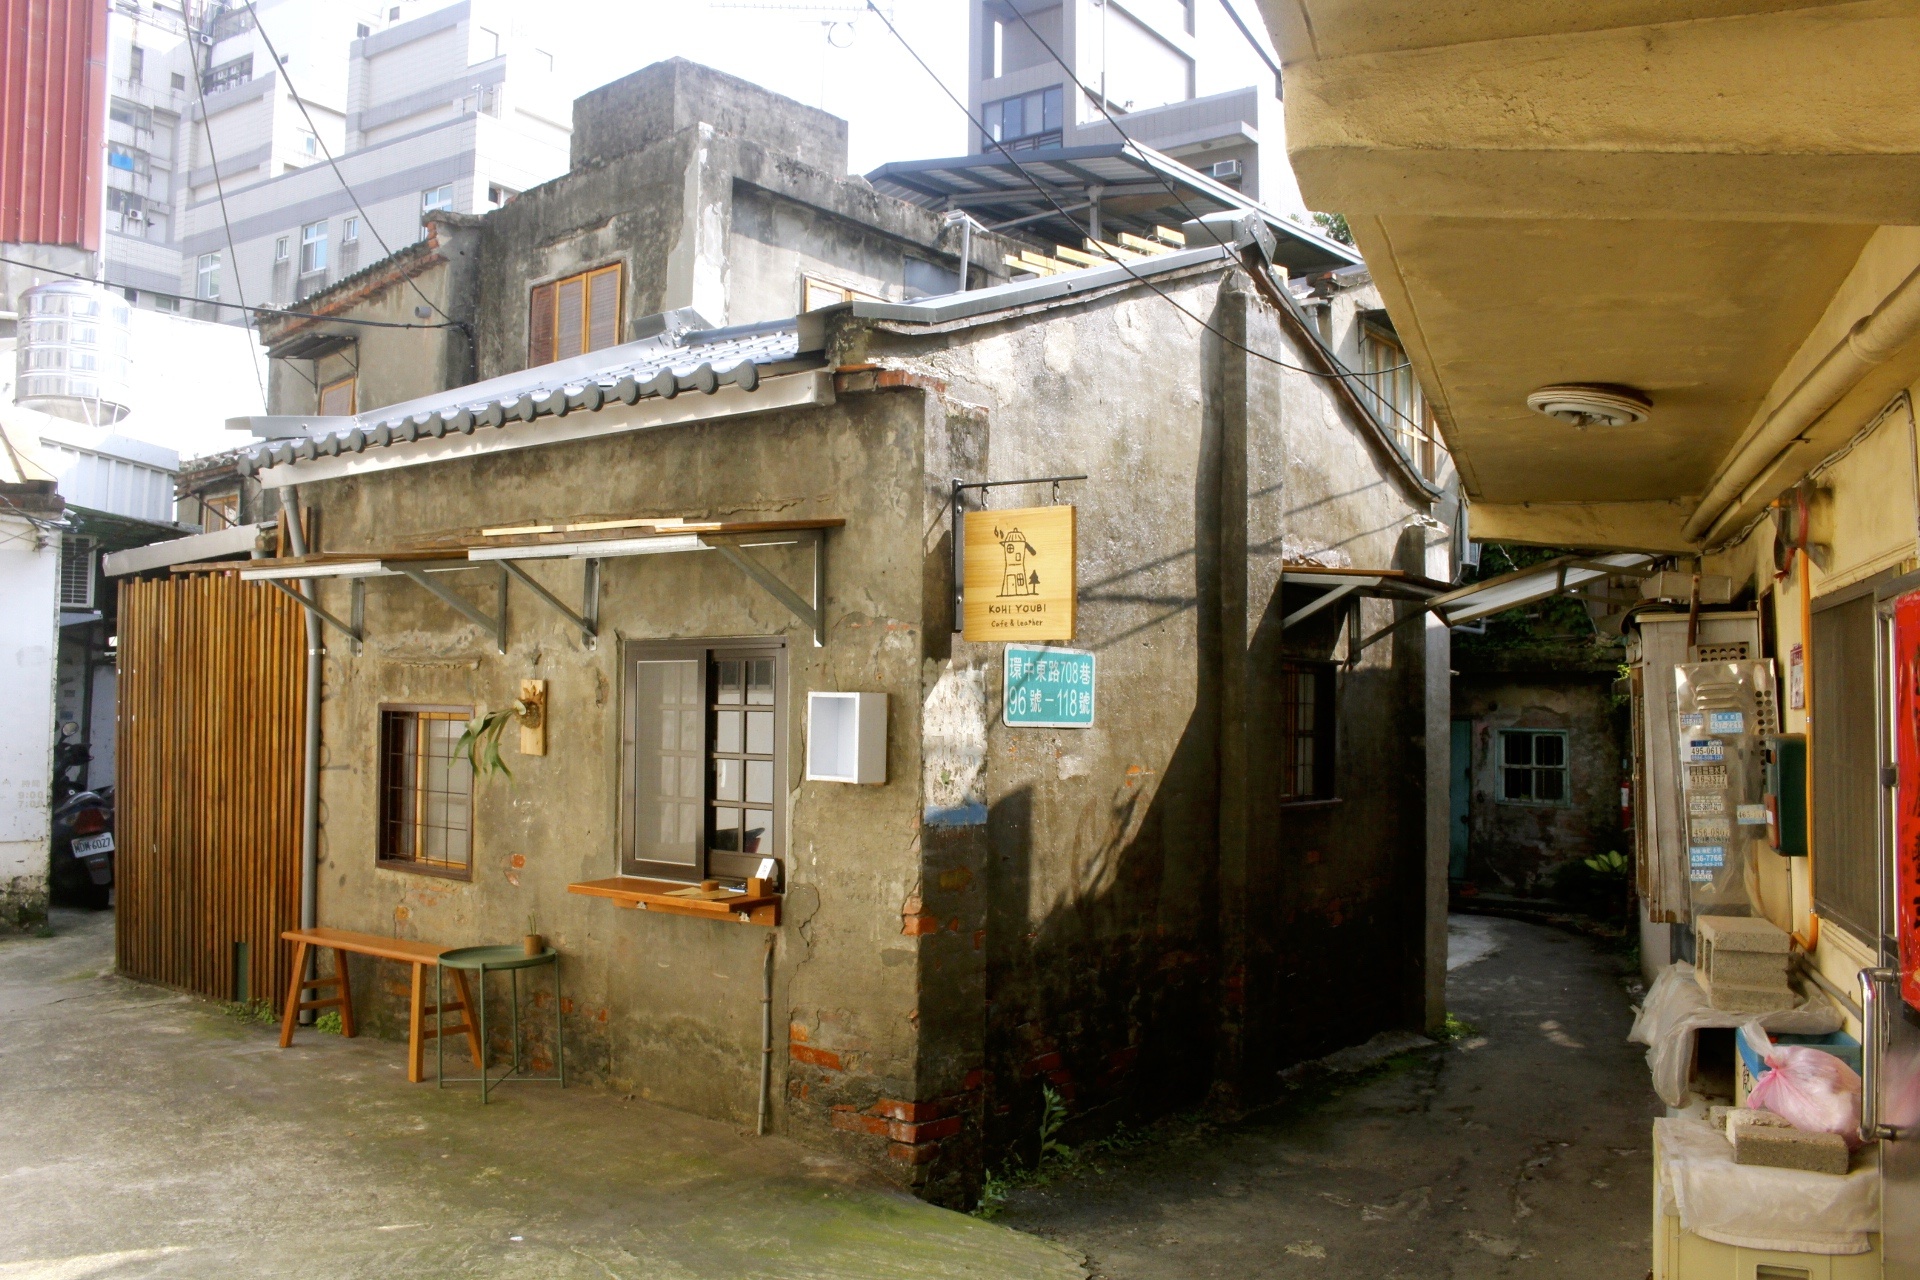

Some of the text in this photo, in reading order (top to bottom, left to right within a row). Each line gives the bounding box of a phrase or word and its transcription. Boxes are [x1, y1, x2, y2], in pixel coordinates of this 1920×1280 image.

[1015, 603, 1047, 613] YOUBI
[1009, 618, 1015, 627] &
[1009, 657, 1091, 685] 環中東路708巷
[1691, 746, 1723, 755] 495-0611
